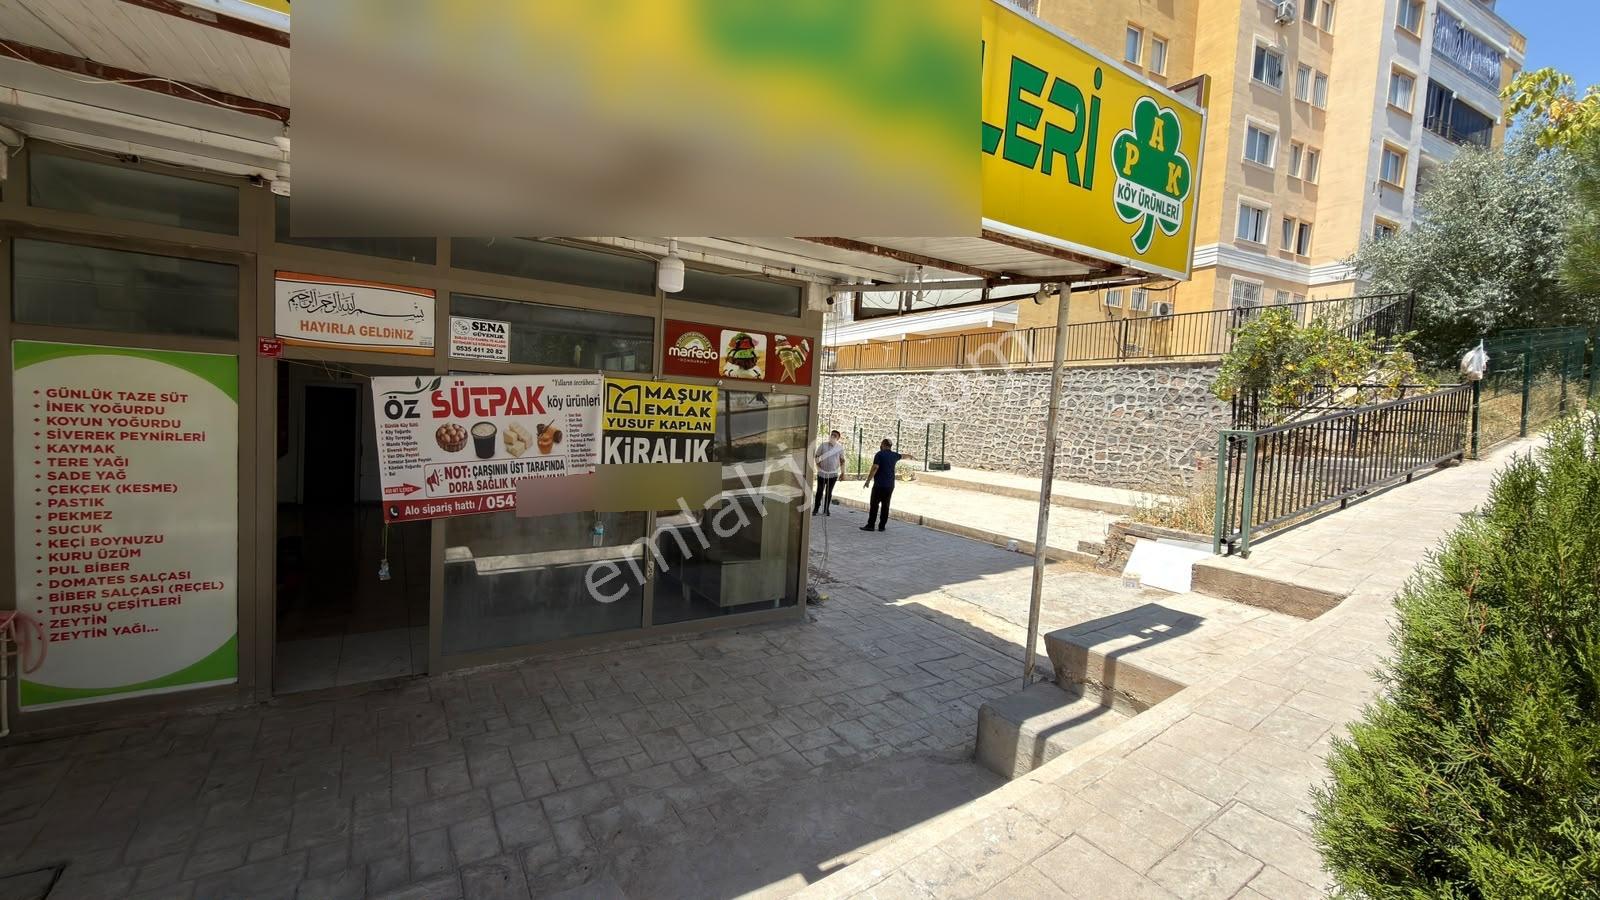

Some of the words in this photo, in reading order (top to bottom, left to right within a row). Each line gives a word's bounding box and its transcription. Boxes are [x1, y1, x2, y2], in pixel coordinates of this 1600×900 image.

[1118, 182, 1137, 202] KÖY
[1139, 189, 1180, 220] ÜRÜNLERİ
[300, 320, 355, 335] HAYIRLA
[471, 321, 505, 333] SENA
[668, 346, 718, 361] marfedo
[46, 387, 113, 400] GÜNLÜK
[117, 391, 157, 402] TAZE
[160, 391, 189, 403] SÜT
[384, 396, 421, 420] ÖZ
[432, 381, 546, 418] SÜTPAK
[547, 395, 564, 410] köy
[566, 394, 600, 407] ürünleri
[645, 386, 713, 404] MAŞUK
[46, 402, 85, 413] İNEK
[90, 403, 165, 415] YOĞURDU
[644, 404, 711, 418] EMLAK
[46, 416, 103, 427] KOYUN
[108, 416, 181, 429] YOĞURDU
[607, 417, 655, 429] YUSUF
[659, 420, 712, 431] KAPLAN
[46, 429, 116, 441] SİVEREK
[120, 430, 206, 442] PEYNİRLERİ
[47, 444, 115, 454] KAYMAK
[47, 457, 89, 467] TERE
[93, 456, 129, 467] YAĞI
[47, 471, 91, 481] SADE
[95, 469, 127, 480] YAĞ
[444, 466, 471, 480] NOT:
[472, 463, 508, 481] ÇARŞININ
[510, 461, 524, 474] ÜST
[526, 460, 565, 473] TARAFINDA
[47, 484, 111, 496] ÇEKÇEK
[115, 483, 178, 494] (KESME)
[449, 481, 474, 493] DORA
[477, 477, 508, 490] SAĞLIK
[47, 497, 105, 508] PASTIK
[405, 506, 420, 516] Alo
[422, 503, 452, 517] sipariş
[455, 501, 475, 514] hattı
[486, 495, 517, 509] 054
[47, 510, 113, 522] PEKMEZ
[47, 524, 103, 535] SUCUK
[48, 537, 85, 549] KEÇİ
[90, 535, 164, 547] BOYNUZU
[48, 551, 93, 562] KURU
[97, 548, 141, 559] ÜZÜM
[49, 565, 80, 576] PUL
[84, 562, 130, 573] BİBER
[49, 576, 126, 589] DOMATES
[130, 571, 191, 583] SALÇASI
[49, 590, 96, 602] BİBER
[101, 585, 164, 598] SALÇASI
[168, 582, 225, 594] (REÇEL)
[50, 603, 102, 616] TURŞU
[107, 596, 181, 612] ÇEŞİTLERİ
[49, 615, 107, 629] ZEYTİN
[49, 628, 107, 642] ZEYTİN
[112, 623, 159, 636] YAĞI...
